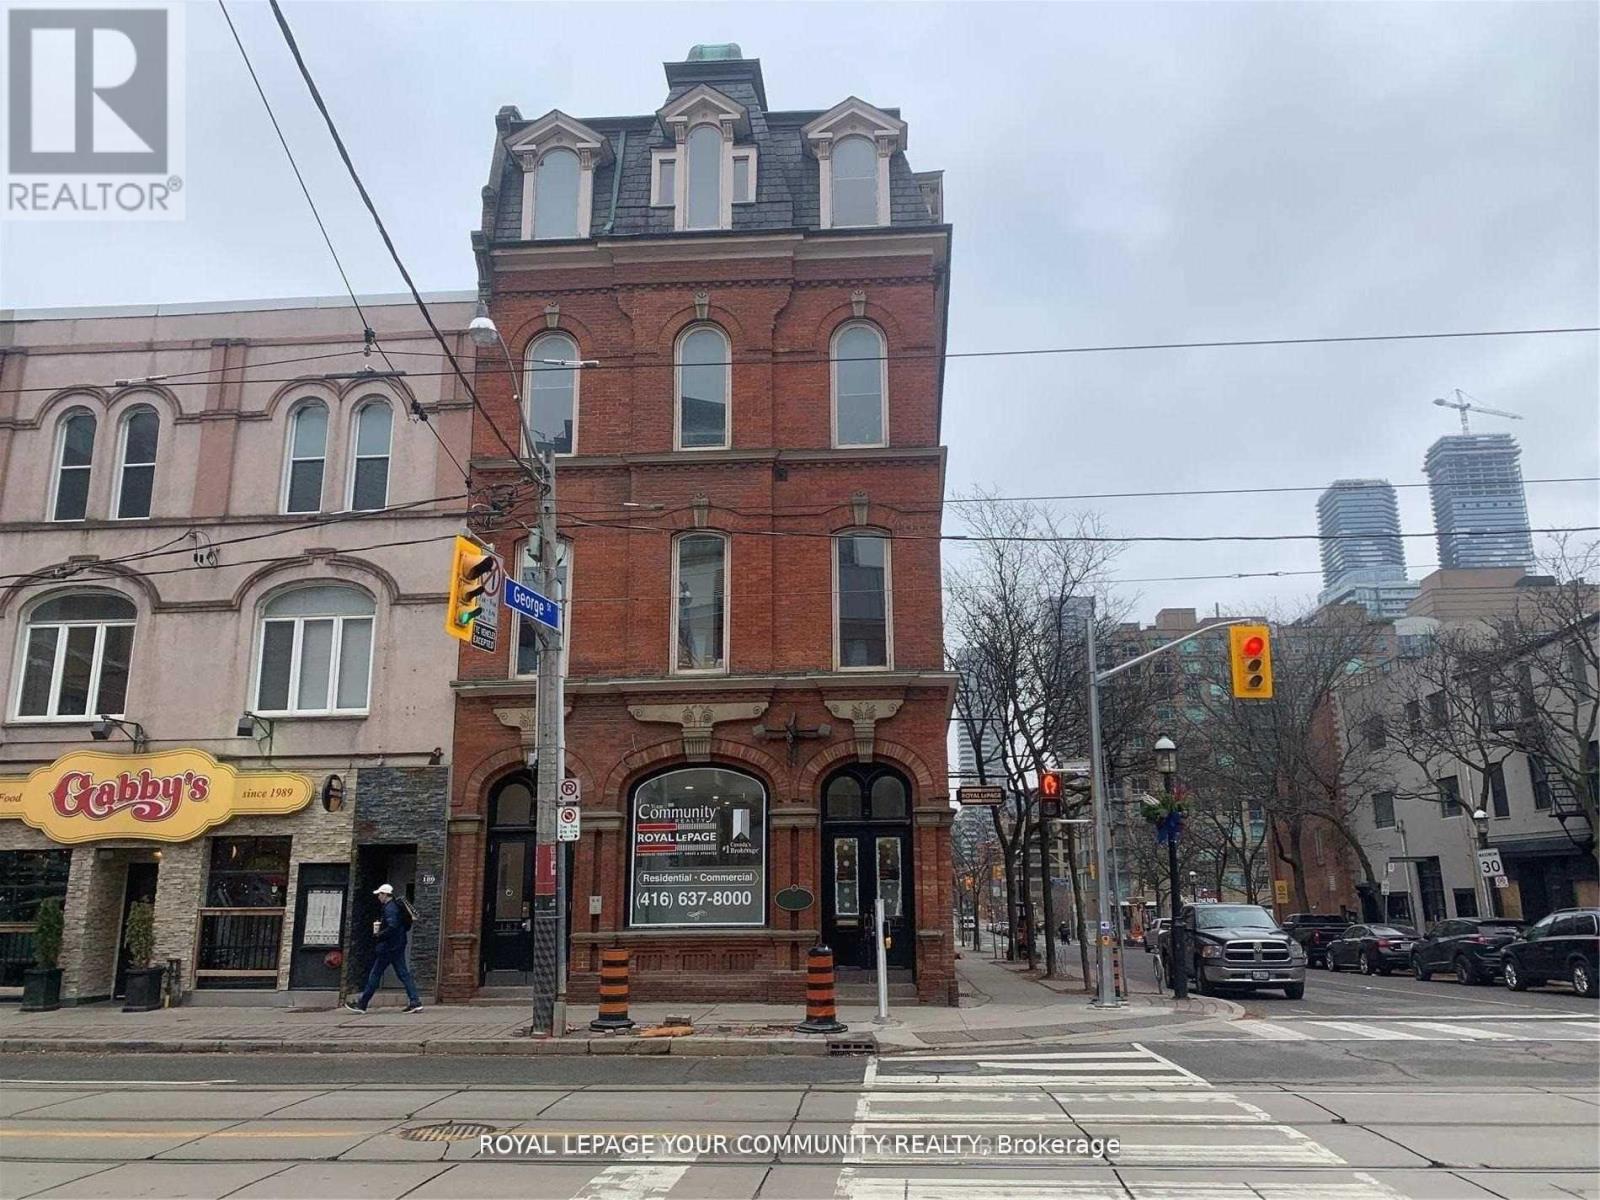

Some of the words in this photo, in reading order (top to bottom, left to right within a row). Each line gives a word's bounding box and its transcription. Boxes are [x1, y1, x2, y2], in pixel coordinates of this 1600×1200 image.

[513, 586, 544, 618] George
[49, 768, 211, 822] Gabby's
[242, 788, 268, 798] since
[270, 788, 294, 798] 1989
[638, 804, 717, 823] Community
[637, 833, 675, 842] ROYAL
[1481, 860, 1501, 873] 30
[643, 873, 692, 882] Residential
[700, 872, 753, 882] Commercial
[636, 892, 674, 909] (416)
[678, 890, 752, 906] 637-8000
